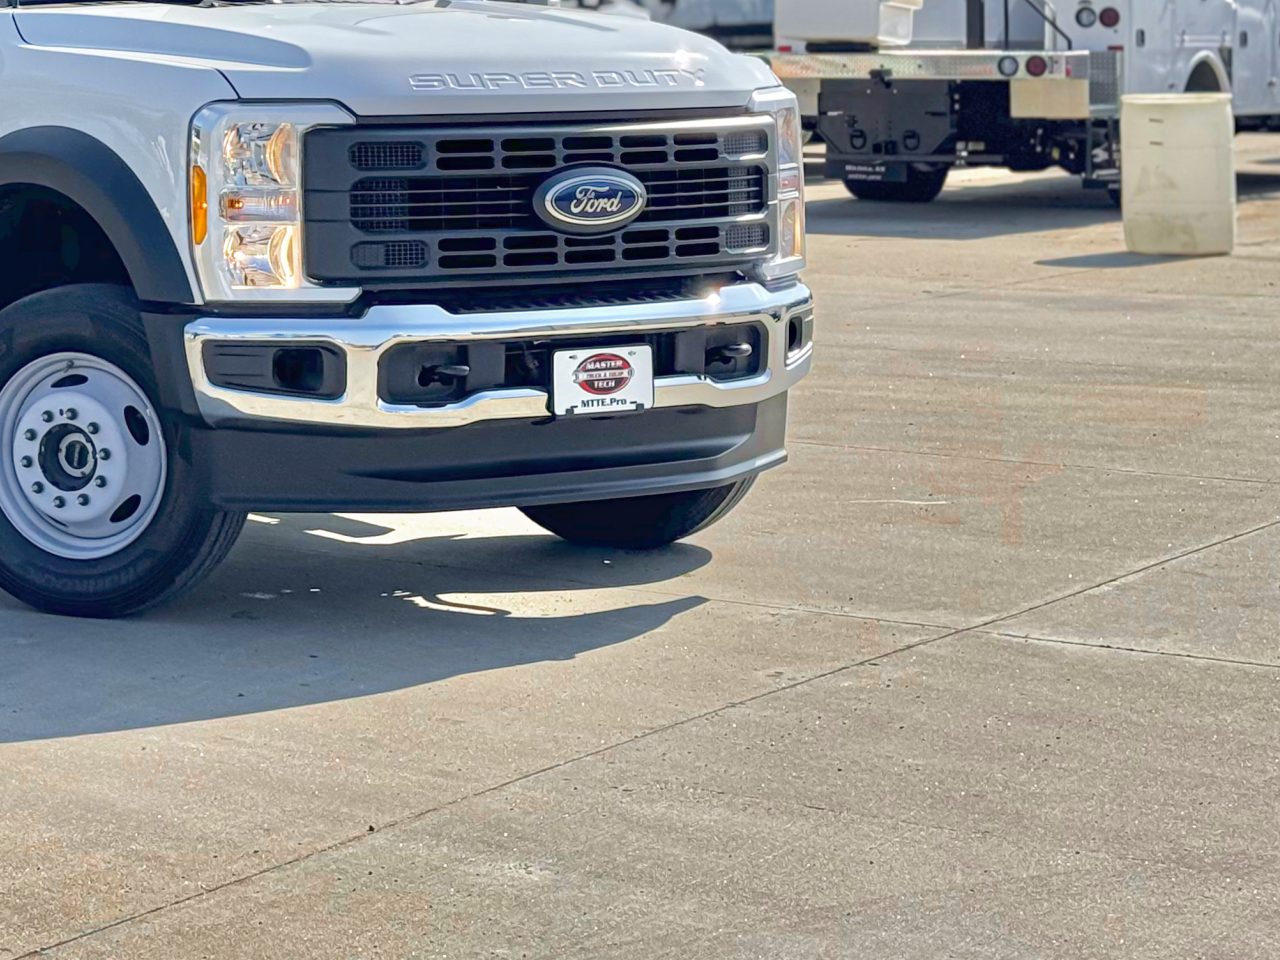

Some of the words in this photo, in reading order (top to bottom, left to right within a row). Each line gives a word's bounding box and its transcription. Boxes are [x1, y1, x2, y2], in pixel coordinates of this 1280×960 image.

[408, 71, 585, 91] SUPER
[591, 68, 706, 88] DUTY
[570, 185, 622, 214] Ford
[586, 360, 624, 370] MASTER
[594, 380, 615, 389] TECH
[581, 398, 627, 408] MTTE.Pro
